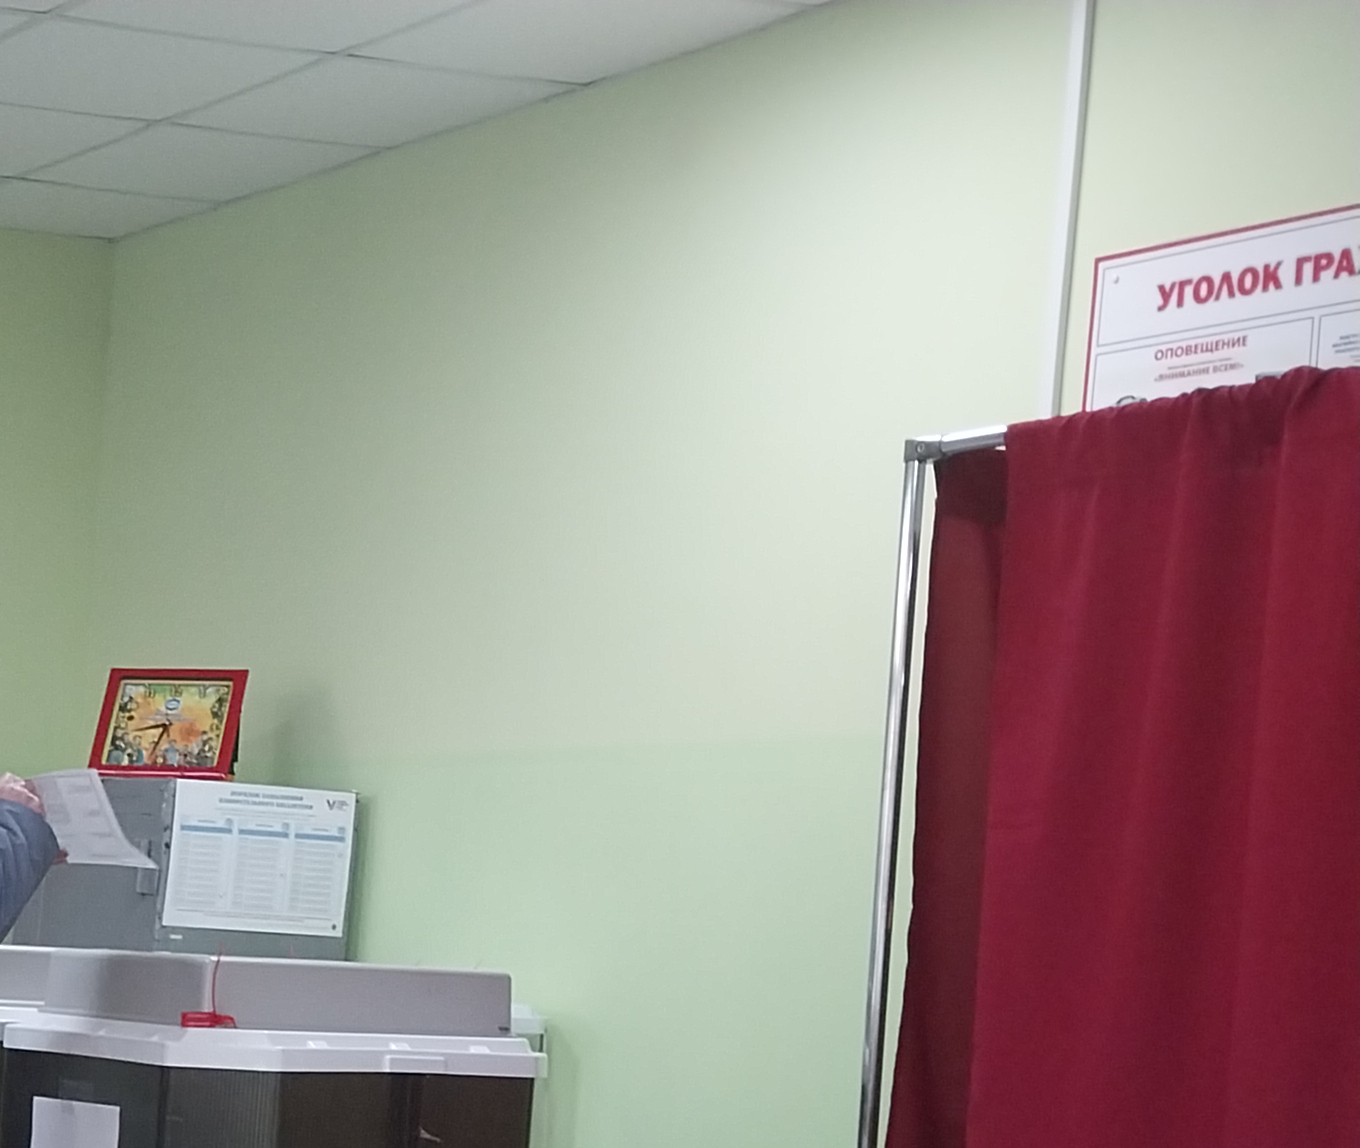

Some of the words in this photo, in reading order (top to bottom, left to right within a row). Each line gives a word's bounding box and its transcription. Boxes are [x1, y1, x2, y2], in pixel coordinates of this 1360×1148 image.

[1156, 260, 1284, 313] УГОЛОК
[1295, 246, 1360, 287] ГРА
[1154, 335, 1248, 361] ОПОВЕЩЕНИЕ
